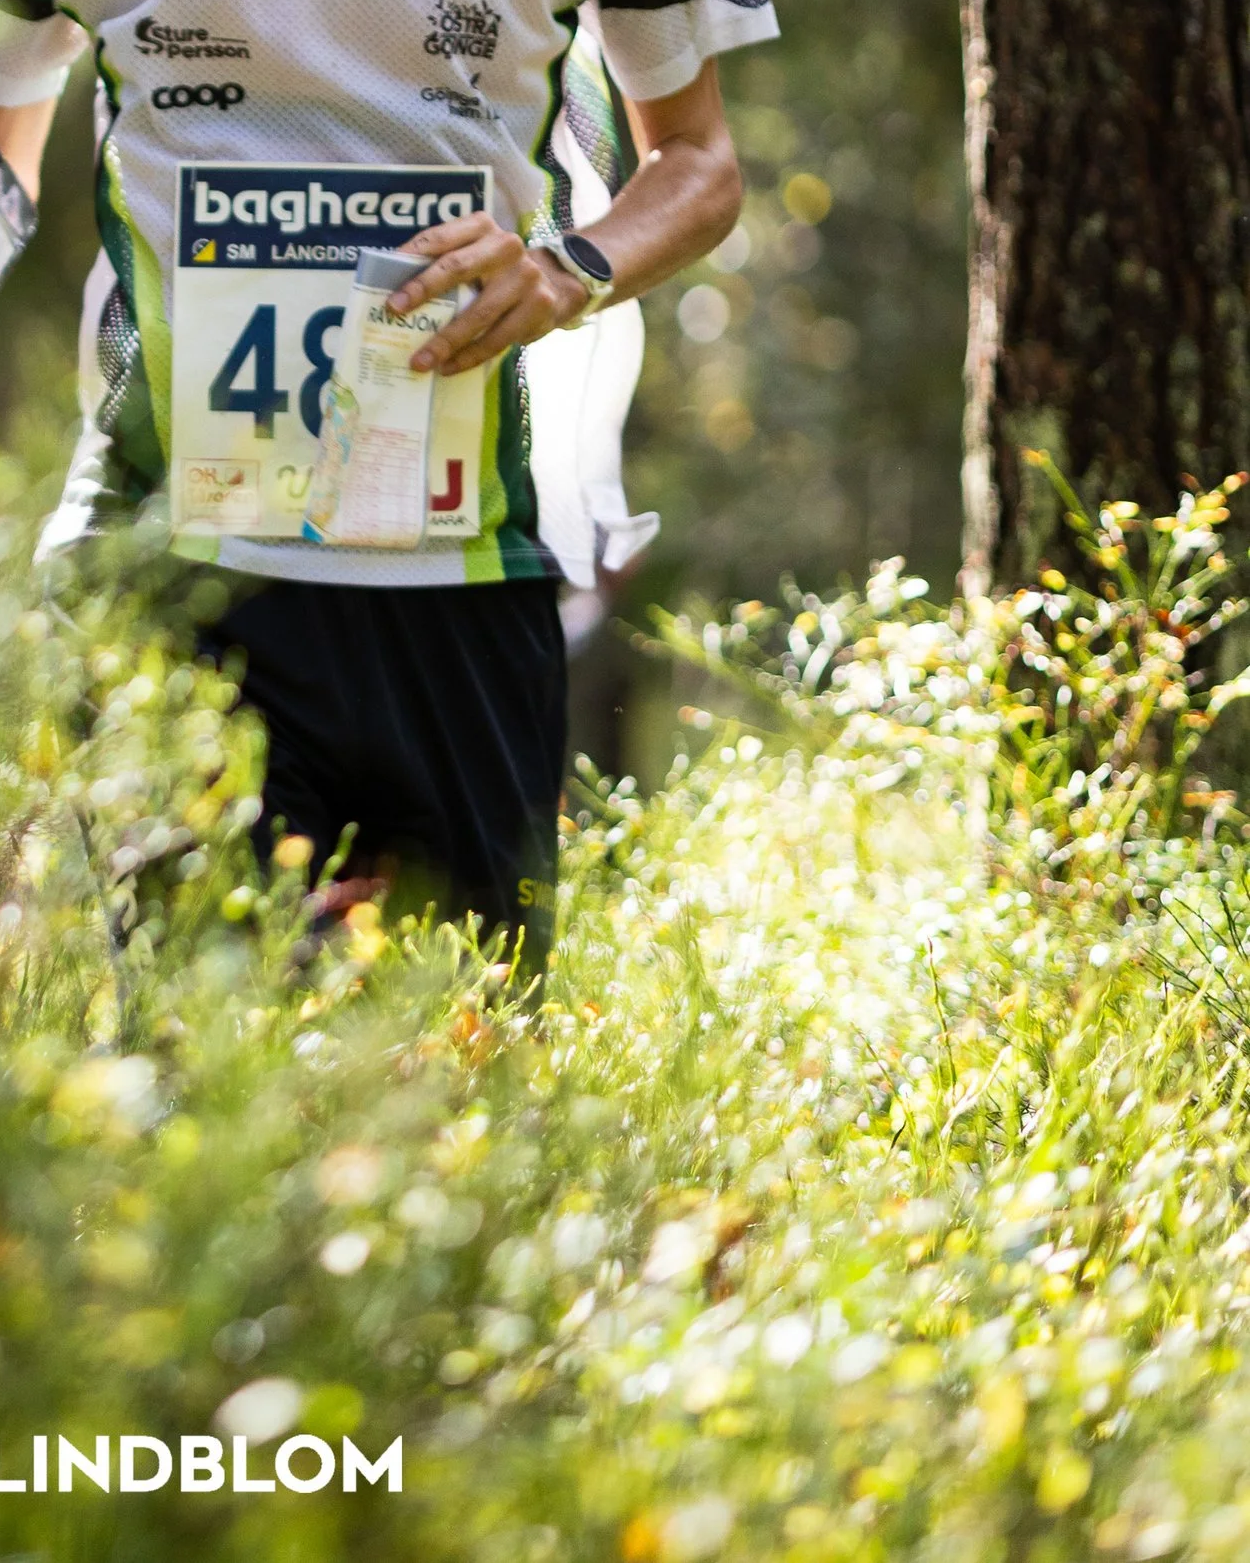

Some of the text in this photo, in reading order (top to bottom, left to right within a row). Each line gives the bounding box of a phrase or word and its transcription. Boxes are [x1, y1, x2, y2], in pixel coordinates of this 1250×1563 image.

[151, 81, 245, 112] coop
[194, 181, 473, 233] bagheera
[226, 243, 257, 260] SM
